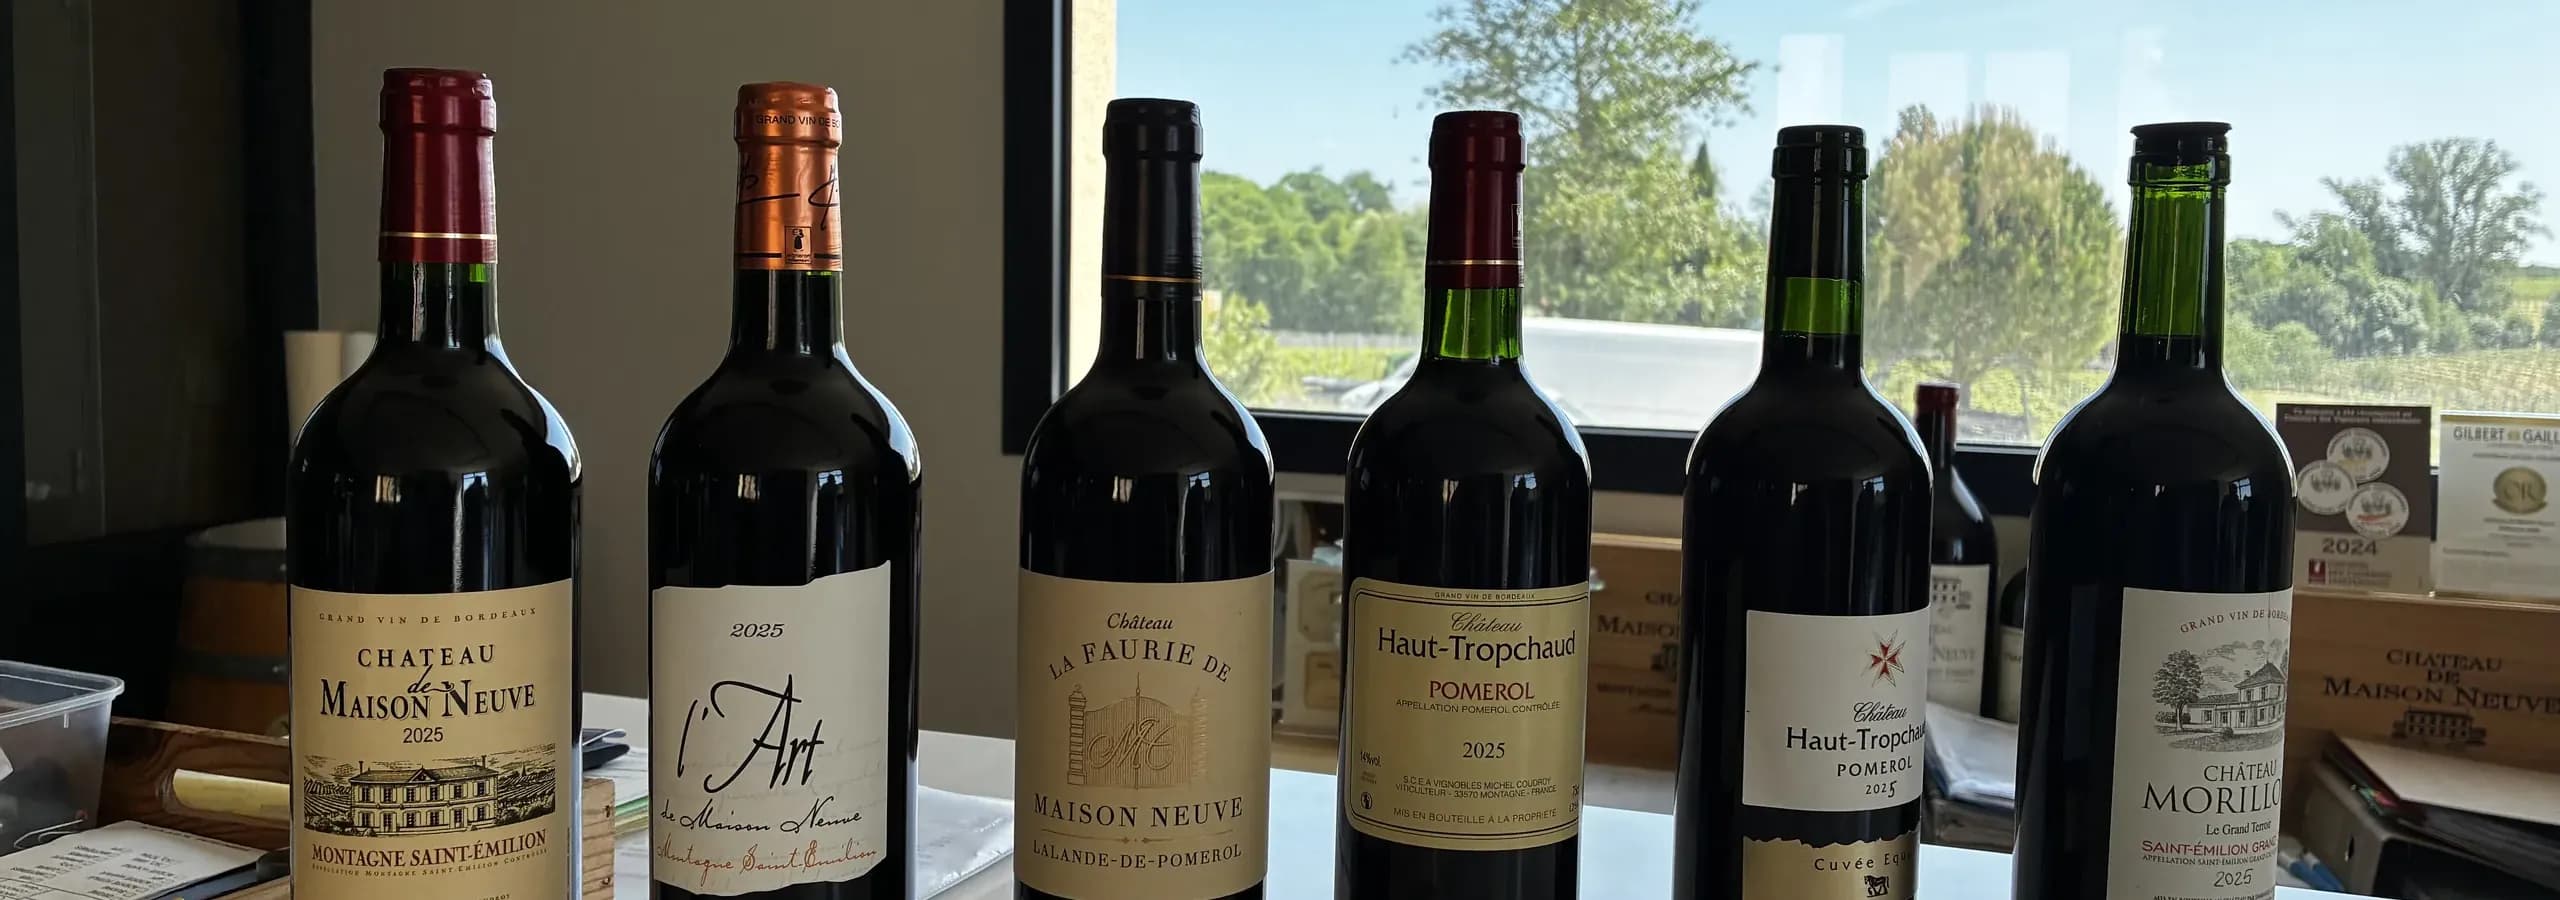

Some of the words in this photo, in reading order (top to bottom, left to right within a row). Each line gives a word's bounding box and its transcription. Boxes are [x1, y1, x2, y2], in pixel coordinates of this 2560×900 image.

[756, 114, 795, 125] GRAND
[798, 116, 816, 125] VIN
[2453, 426, 2505, 441] GILBERT
[2321, 536, 2377, 556] 2024
[1434, 591, 1462, 600] GRAND
[1465, 592, 1480, 600] VIN
[1495, 592, 1536, 601] BORDEAUX
[319, 612, 365, 624] GRAND
[376, 615, 408, 625] VIN
[420, 615, 441, 625] DE
[453, 607, 538, 623] BORDEAUX
[1106, 611, 1175, 631] Château
[1451, 610, 1523, 633] Château
[2180, 614, 2225, 633] GRAND
[2229, 610, 2249, 621] VIN
[2252, 609, 2265, 619] DE
[729, 622, 785, 638] 2025
[357, 643, 495, 668] CHATEAU
[1378, 626, 1576, 668] Haut-Tropchaud
[1049, 655, 1075, 681] LA
[1081, 638, 1196, 665] FAURIE
[1202, 655, 1232, 683] DE
[2386, 649, 2503, 673] CHATEAU
[2426, 669, 2461, 685] DE
[319, 678, 431, 720] MAISON
[440, 679, 536, 718] NEUVE
[1429, 680, 1536, 701] POMEROL
[2322, 676, 2443, 704] MAISON
[2455, 686, 2560, 715] NEUVE
[1396, 699, 1459, 713] APPELLATION
[1461, 705, 1510, 714] POMEROL
[1853, 701, 1908, 723] Château
[402, 727, 444, 744] 2025
[1462, 741, 1506, 759] 2025
[1837, 755, 1913, 777] POMEROL
[2203, 759, 2277, 782] CHÂTEAU
[1395, 783, 1447, 798] VITICULTEUR
[1454, 789, 1479, 799] 33570
[1480, 789, 1526, 799] MONTAGNE
[1531, 784, 1558, 797] FRANCE
[1433, 778, 1482, 790] VIGNOBLES
[1483, 780, 1515, 790] MICHEL
[1865, 780, 1898, 798] 2025
[659, 799, 676, 822] de
[679, 797, 771, 831] Maison
[779, 795, 863, 834] Neuve
[1034, 792, 1139, 829] MAISON
[1150, 795, 1244, 828] NEUVE
[1393, 807, 1410, 818] MIS
[1412, 810, 1426, 819] EN
[1428, 812, 1485, 824] BOUTEILLE
[1497, 815, 1510, 824] LA
[2206, 823, 2220, 836] Le
[2222, 822, 2250, 836] Grand
[311, 843, 406, 868] MONTAGNE
[409, 829, 547, 867] SAINT-ÉMILION
[1032, 839, 1243, 870] LALANDE-DE-POMEROL
[2141, 840, 2249, 857] SAINT-ÉMILION
[656, 832, 734, 887] Montagne
[1814, 857, 1875, 871] Cuvée
[1883, 851, 1910, 867] Equ
[2213, 868, 2254, 888] 2025
